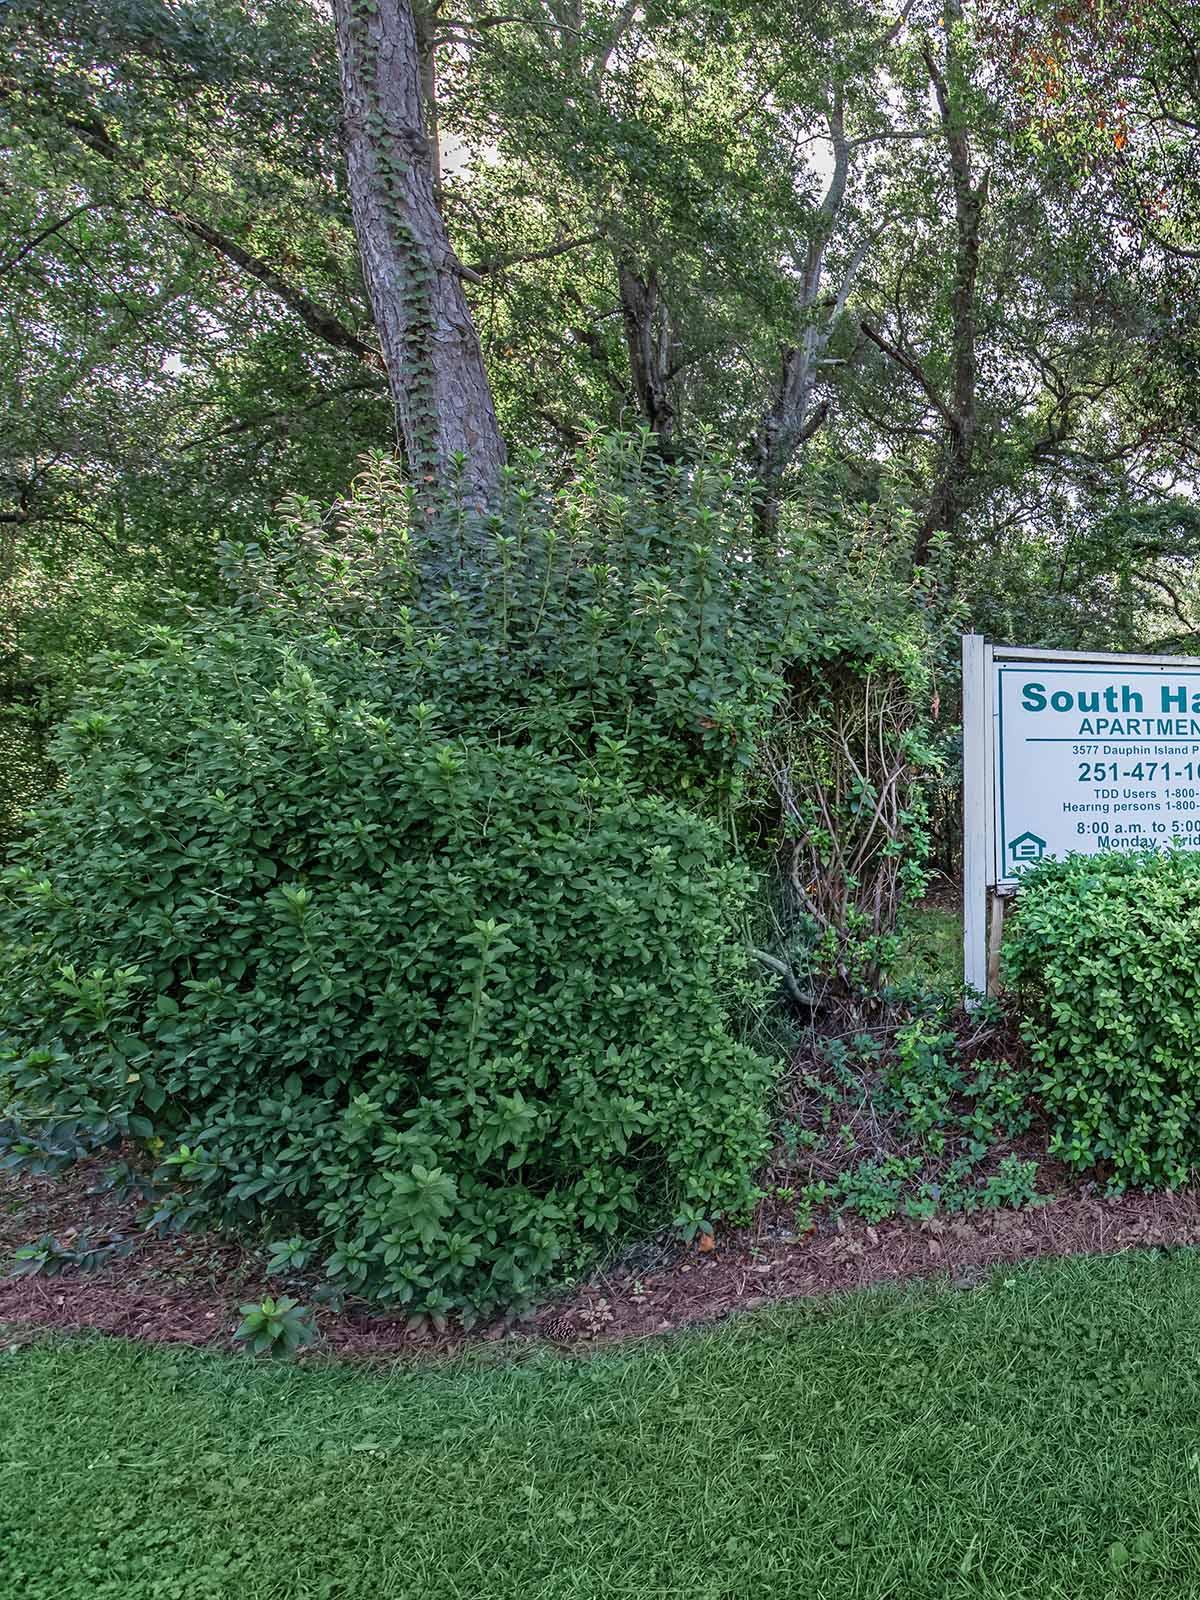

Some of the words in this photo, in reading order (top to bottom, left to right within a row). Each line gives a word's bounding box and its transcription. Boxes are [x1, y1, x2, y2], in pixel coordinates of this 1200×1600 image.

[1022, 682, 1143, 712] South
[1072, 745, 1099, 755] 3577
[1103, 745, 1151, 756] Dauphin
[1154, 745, 1187, 755] Island
[1094, 789, 1119, 799] TDD
[1123, 789, 1157, 799] Users
[1063, 803, 1110, 814] Hearing
[1113, 803, 1161, 813] persons
[1077, 822, 1109, 834] 8:00
[1114, 824, 1147, 833] a.m.
[1152, 822, 1166, 833] to
[1097, 836, 1157, 849] Monday
